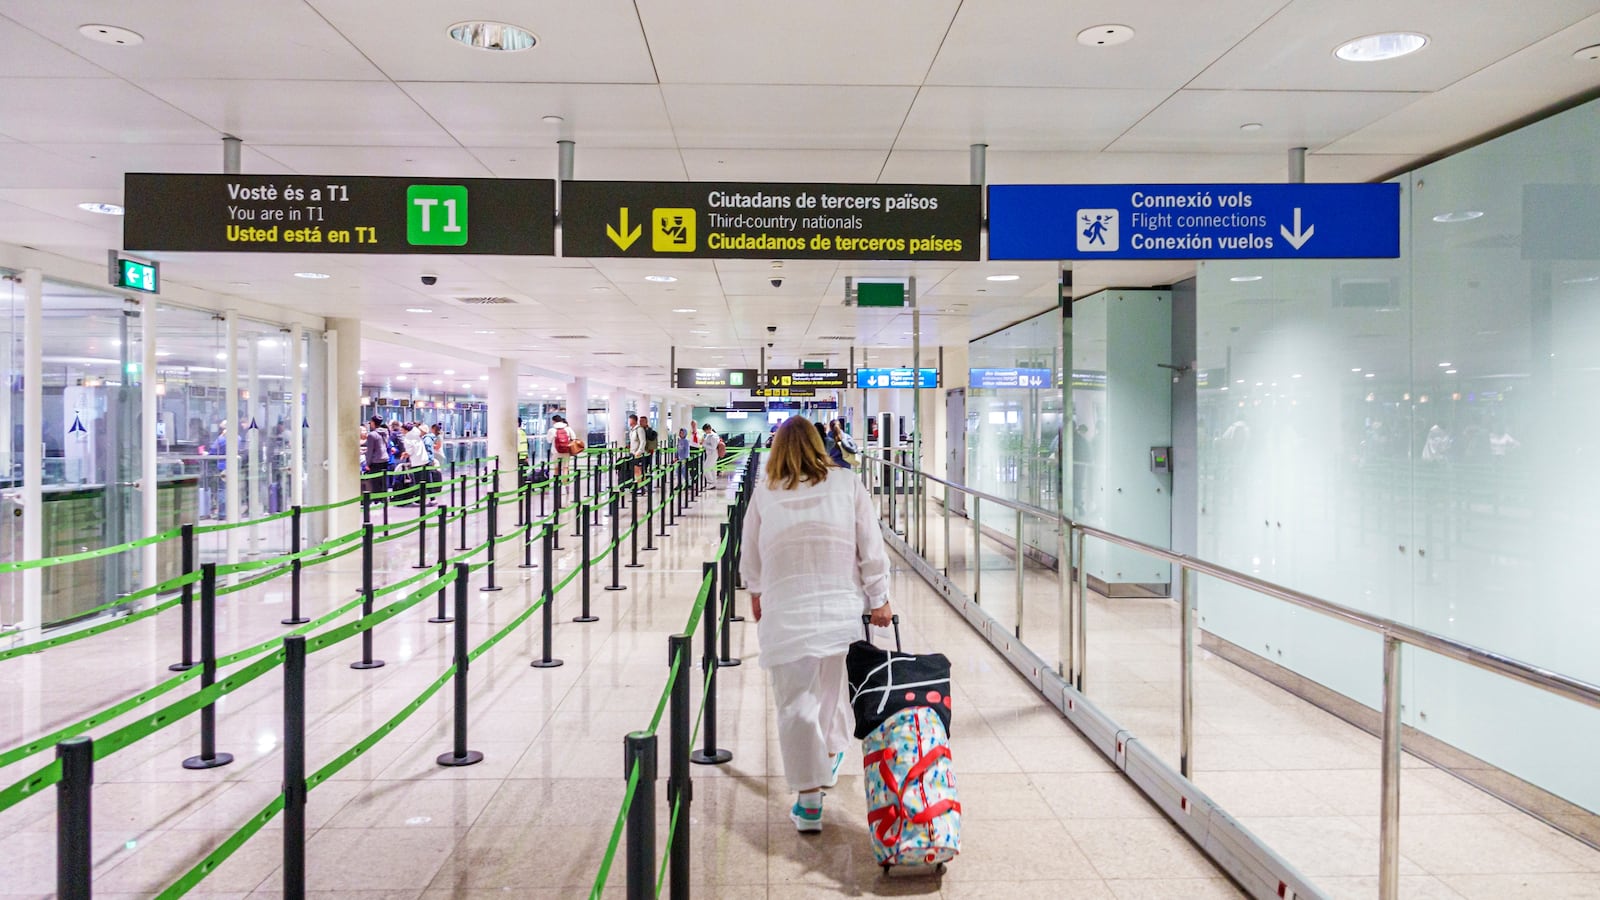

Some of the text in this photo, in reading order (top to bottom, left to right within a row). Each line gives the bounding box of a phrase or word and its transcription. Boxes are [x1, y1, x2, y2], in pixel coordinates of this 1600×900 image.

[228, 183, 349, 201] Vostè és a T1
[1132, 191, 1252, 207] Connexió vols
[708, 191, 938, 213] Ciutadans de tercers països
[228, 206, 324, 221] You are in T1
[414, 199, 461, 232] T1
[708, 213, 862, 230] Third-country nationals
[1132, 213, 1266, 230] Flight connections
[227, 225, 377, 243] Usted está en T1
[1131, 233, 1273, 249] Conexión vuelos
[708, 233, 962, 254] Ciudadanos de terceros países
